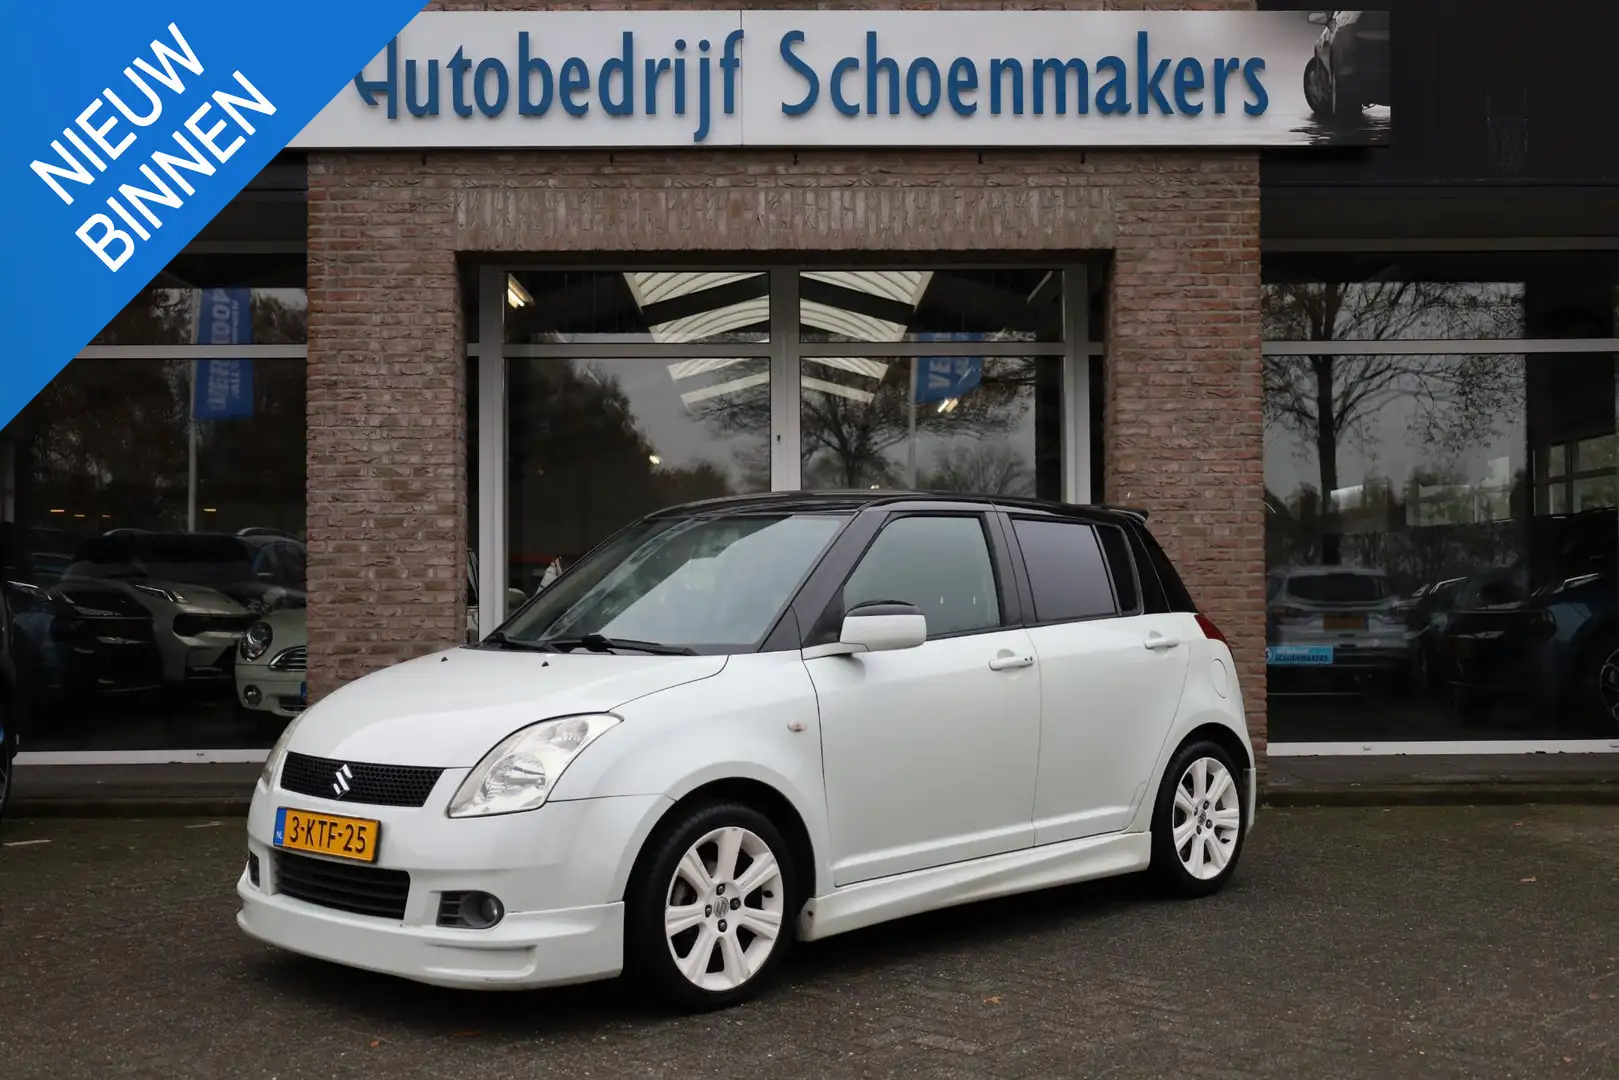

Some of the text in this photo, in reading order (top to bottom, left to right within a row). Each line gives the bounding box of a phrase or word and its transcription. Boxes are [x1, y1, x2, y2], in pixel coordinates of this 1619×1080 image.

[353, 30, 1269, 142] Autobedrijf Schoenmakers
[290, 816, 367, 854] 3-KTF-25
